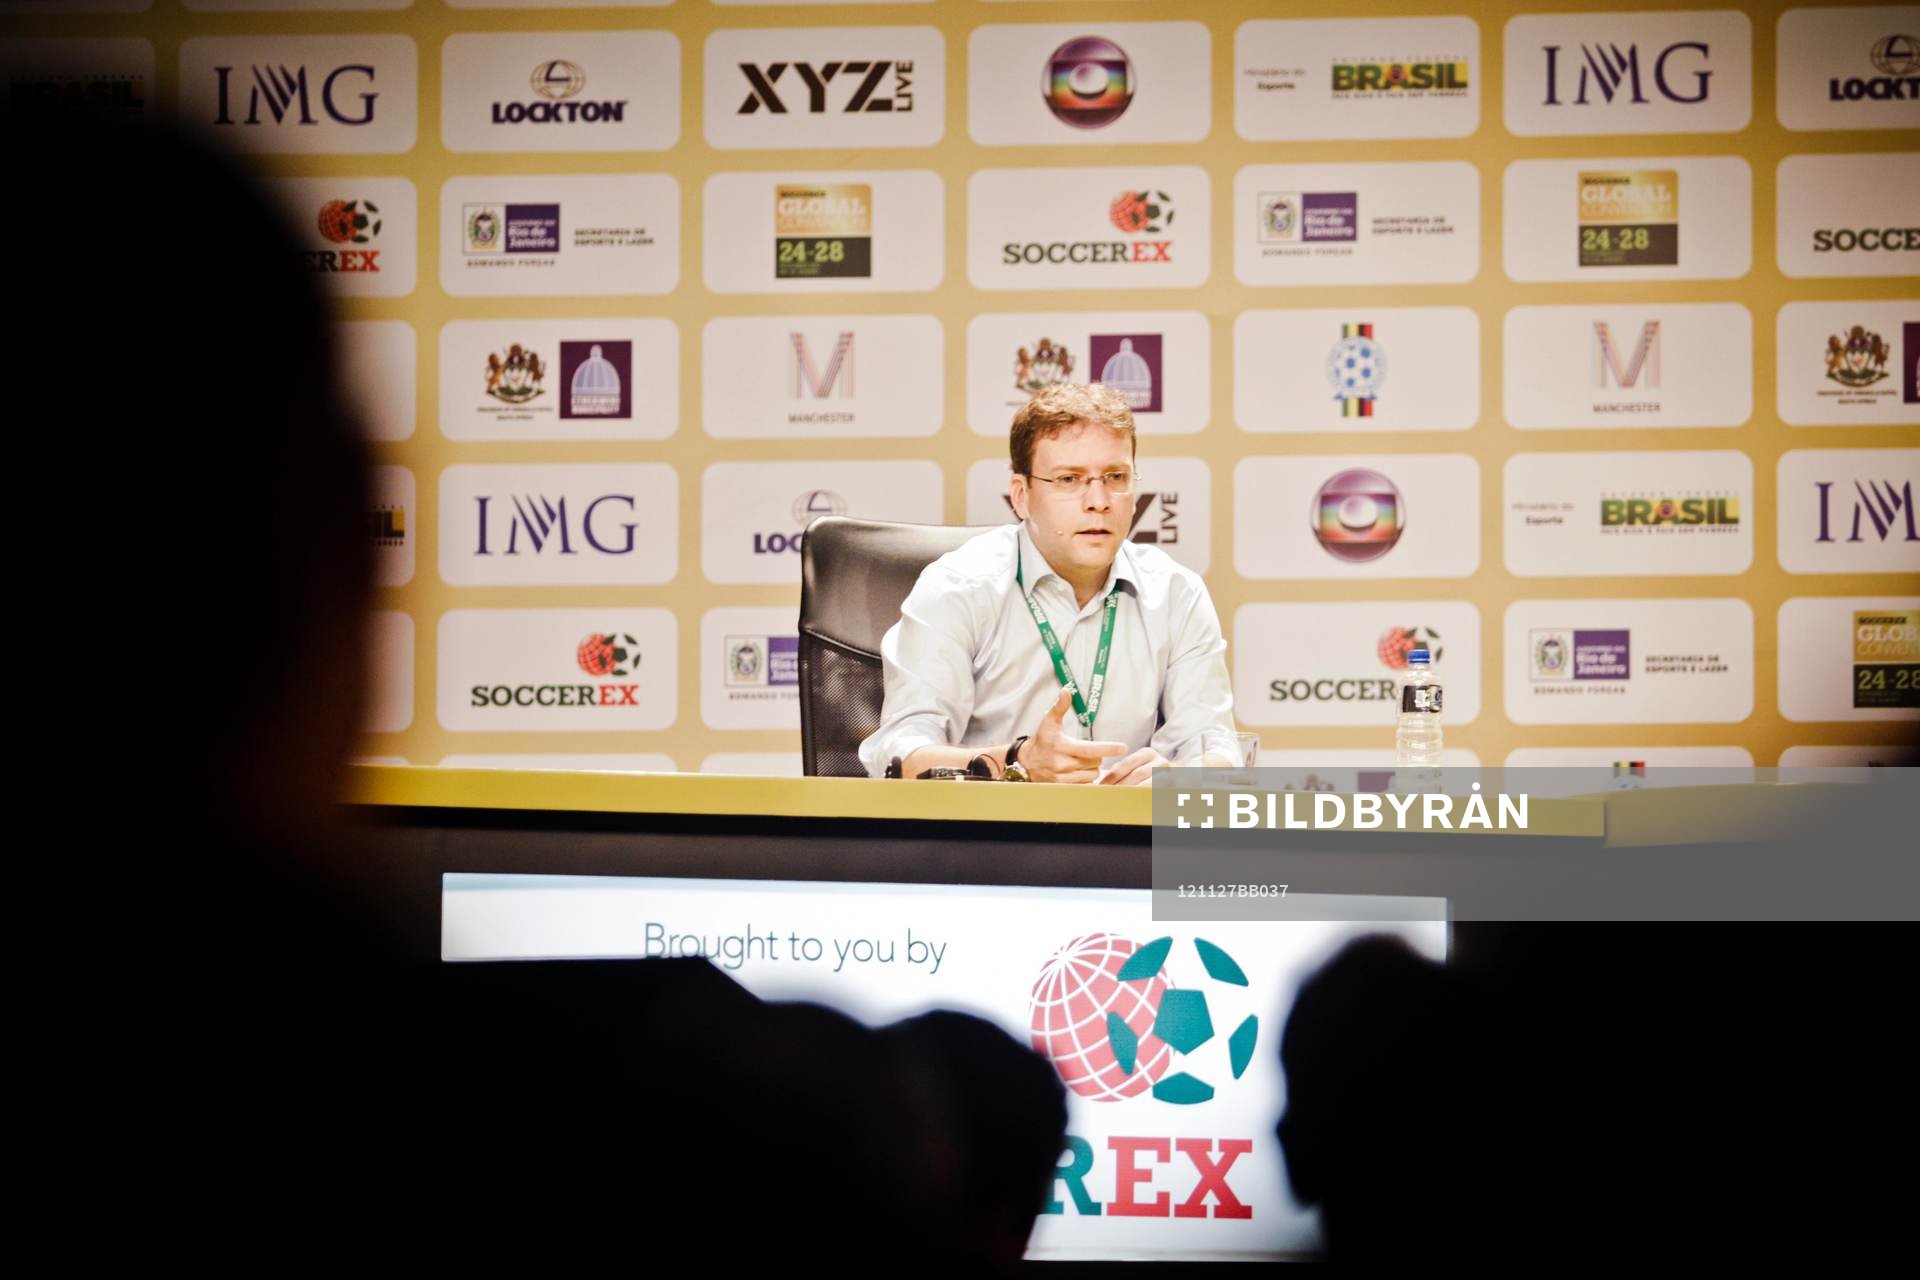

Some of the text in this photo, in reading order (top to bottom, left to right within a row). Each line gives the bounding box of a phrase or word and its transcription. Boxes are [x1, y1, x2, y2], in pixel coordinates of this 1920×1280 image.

[894, 60, 914, 112] LIVE
[1331, 63, 1468, 91] BRASIL
[1542, 42, 1713, 105] IMG
[213, 64, 379, 126] IMG
[737, 61, 893, 114] XYZ
[492, 101, 625, 124] LOCKTON
[779, 240, 844, 262] 24-28
[1003, 240, 1172, 265] SOCCEREX
[1582, 227, 1649, 251] 24-28
[788, 412, 855, 424] MANCHESTER
[1593, 402, 1661, 414] MANCHESTER
[474, 493, 639, 555] IMG
[1160, 492, 1178, 544] LIVE
[1601, 498, 1740, 525] BRASIL
[471, 684, 639, 707] SOCCEREX
[1269, 679, 1398, 701] SOCCER
[645, 922, 948, 974] Brought to you by
[1042, 1135, 1253, 1220] REX
